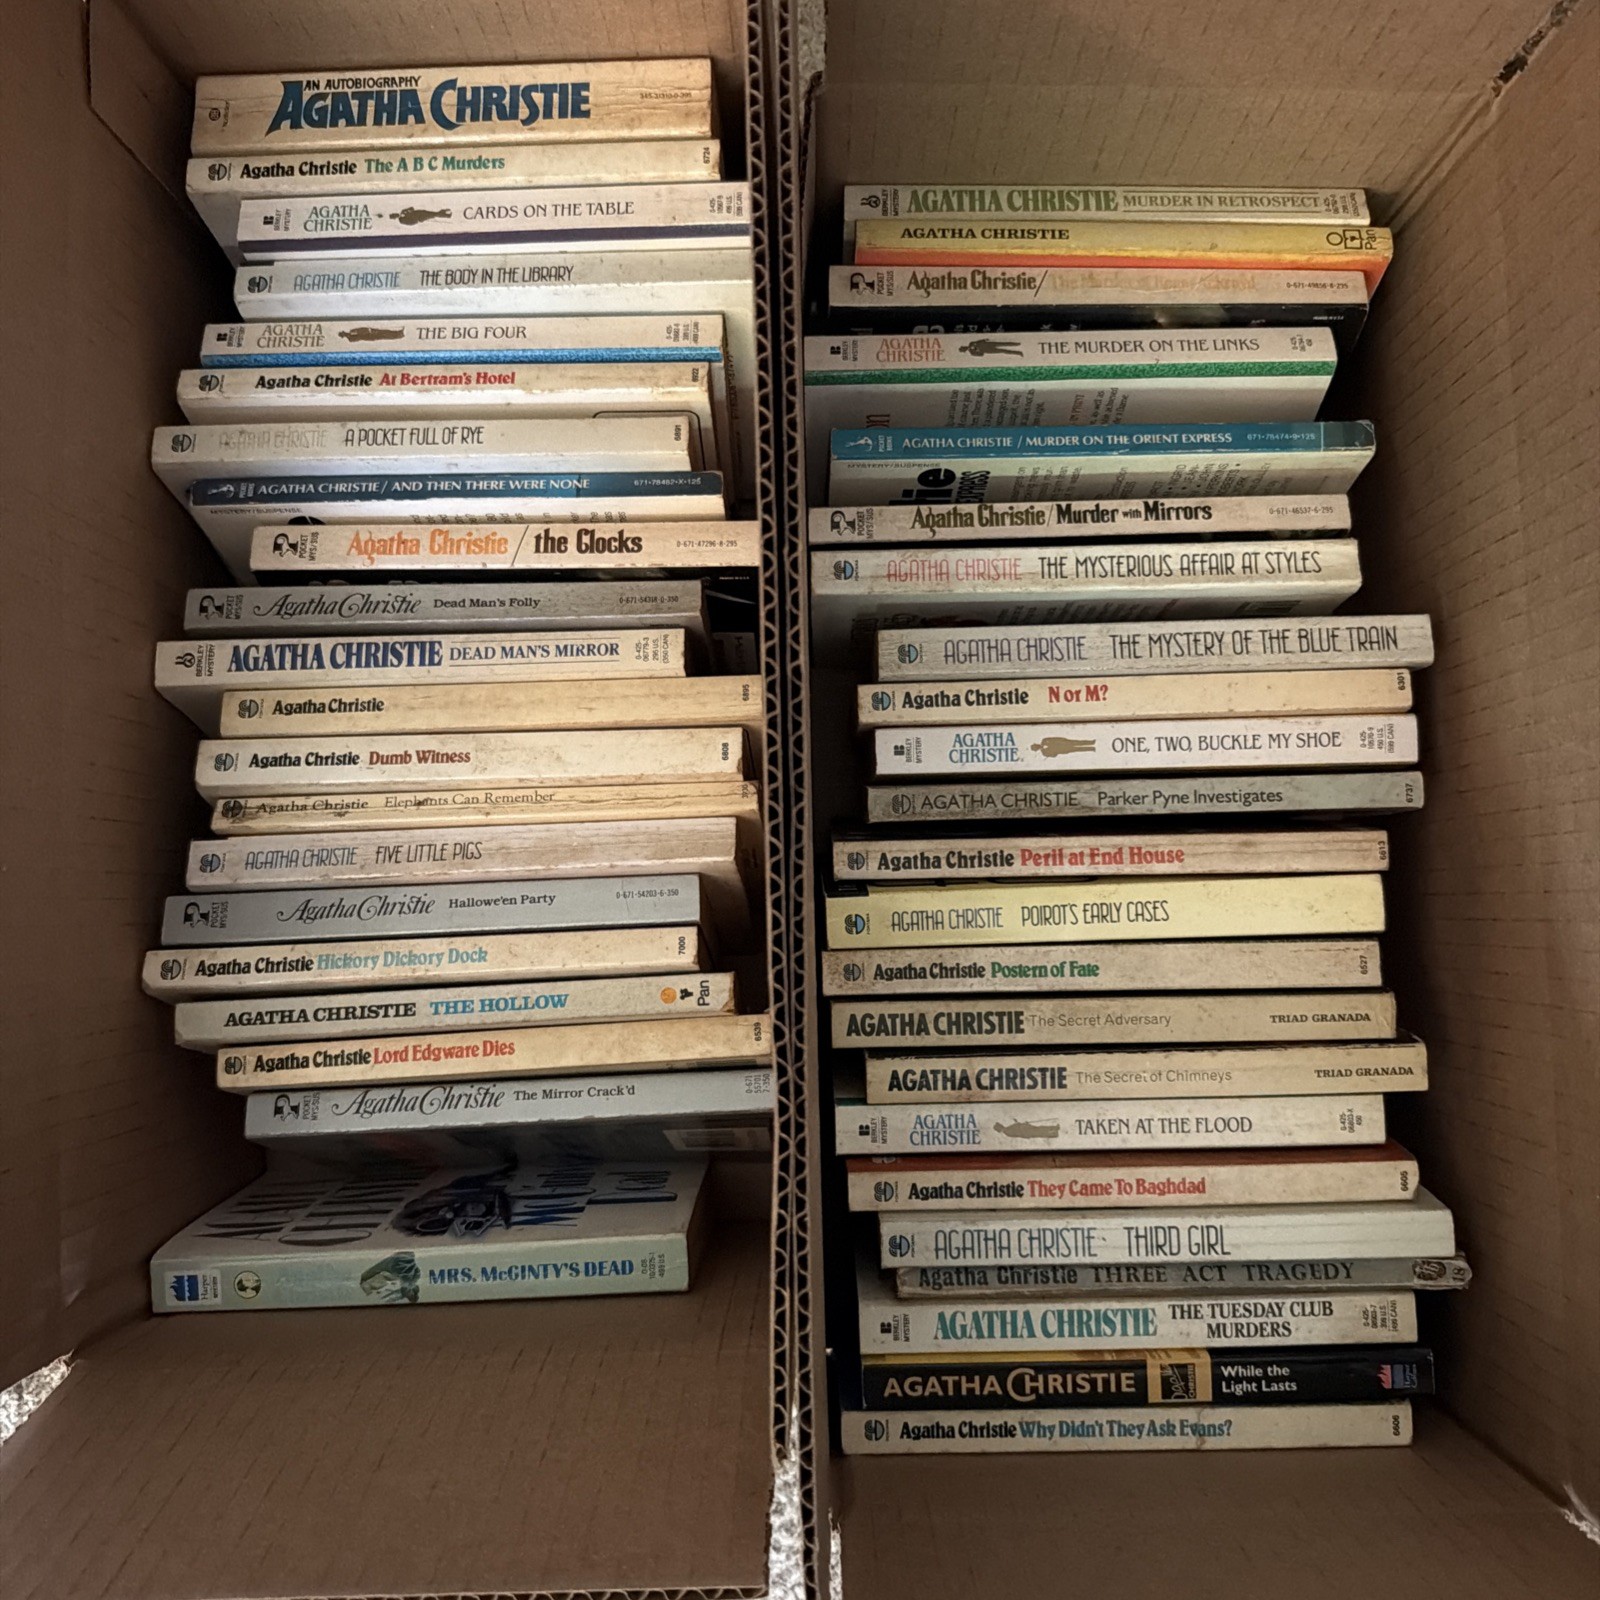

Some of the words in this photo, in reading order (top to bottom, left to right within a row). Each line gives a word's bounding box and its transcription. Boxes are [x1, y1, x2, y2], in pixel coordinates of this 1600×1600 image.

[324, 76, 422, 89] AUTOBIOGRAPHY
[265, 80, 426, 137] AGATHA
[431, 77, 590, 131] CHRISTIE
[364, 158, 393, 173] The
[442, 155, 505, 170] Murders
[463, 206, 518, 220] CARDS
[554, 203, 582, 216] THE
[586, 202, 635, 215] TABLE
[907, 189, 1002, 213] AGATHA
[1007, 189, 1118, 212] CHRISTIE
[1123, 195, 1192, 208] MURDER
[1217, 195, 1320, 208] RETROSPECT
[901, 228, 976, 240] AGATHA
[980, 228, 1069, 240] CHRISTIE
[1365, 230, 1376, 250] Pan
[420, 270, 442, 285] THE
[445, 268, 478, 285] BODY
[497, 267, 519, 283] THE
[522, 266, 574, 282] LIBRARY
[417, 327, 447, 339] THE
[451, 327, 478, 339] BIG
[484, 326, 527, 339] FOUR
[1038, 341, 1070, 355] THE
[1074, 340, 1144, 354] MURDER
[1176, 339, 1209, 351] THE
[1213, 338, 1260, 350] LINKS
[401, 372, 471, 386] Bertram's
[476, 372, 516, 385] Hotel
[359, 428, 405, 446] POCKET
[409, 427, 438, 445] FULL
[461, 426, 485, 445] RYE
[1106, 434, 1130, 445] THE
[1132, 433, 1179, 445] ORIENT
[1182, 433, 1232, 444] EXPRESS
[391, 482, 423, 492] AND
[427, 480, 461, 491] THEN
[465, 480, 506, 490] THERE
[509, 479, 546, 489] WERE
[550, 479, 590, 489] NONE
[1056, 504, 1117, 524] Murder
[1122, 509, 1141, 519] with
[1143, 500, 1212, 521] Mirrors
[299, 534, 307, 558] POCKET
[534, 529, 568, 554] the
[576, 528, 643, 554] Clocks
[1038, 556, 1068, 580] THE
[1075, 554, 1173, 579] MYSTERIOUS
[1180, 552, 1235, 576] AFFAIR
[1265, 551, 1322, 574] STYLES
[434, 598, 465, 608] Dead
[469, 598, 505, 608] Man's
[509, 597, 540, 609] Folly
[1109, 634, 1141, 659] THE
[1150, 631, 1225, 657] MYSTERY
[1258, 629, 1293, 655] THE
[1297, 627, 1342, 653] BLUE
[1346, 625, 1398, 651] TRAIN
[195, 645, 203, 677] BERKLEY
[207, 644, 215, 677] MYSTERY
[227, 644, 326, 672] AGATHA
[329, 641, 443, 669] CHRISTIE
[449, 646, 496, 661] DEAD
[500, 645, 550, 659] MAN'S
[555, 643, 620, 657] MIRROR
[1397, 672, 1405, 690] 6301
[742, 684, 750, 701] 6895
[272, 700, 325, 716] Agatha
[328, 697, 385, 713] Christie
[721, 742, 729, 760] 6808
[1112, 737, 1150, 753] ONE,
[1155, 736, 1192, 751] TWO,
[1199, 735, 1263, 750] BUCKLE
[1296, 732, 1341, 748] SHOE
[369, 751, 412, 765] Dumb
[417, 750, 471, 764] Witness
[385, 796, 449, 808] Elephants
[453, 793, 479, 805] Can
[485, 791, 555, 804] Remember
[1098, 792, 1149, 806] Parker
[1153, 790, 1189, 808] Pyne
[1194, 789, 1283, 806] Investigates
[375, 845, 403, 864] FIVE
[407, 843, 447, 863] LITTLE
[453, 841, 482, 860] PIGS
[1020, 849, 1063, 866] Peril
[1089, 848, 1123, 865] End
[1129, 847, 1185, 864] House
[449, 896, 517, 909] Hallowe'en
[521, 894, 556, 906] Party
[211, 902, 219, 928] POCKET
[1022, 904, 1078, 926] POIROT'S
[1082, 902, 1121, 924] EARLY
[1127, 900, 1169, 922] CASES
[317, 953, 378, 971] Hickory
[384, 950, 445, 968] Dickory
[448, 947, 488, 964] Dock
[991, 962, 1048, 978] Postern
[1069, 961, 1099, 977] Fate
[697, 980, 710, 1007] Pan
[430, 999, 474, 1015] THE
[480, 993, 569, 1013] HOLLOW
[754, 1022, 762, 1042] 6539
[847, 1013, 930, 1036] AGATHA
[934, 1011, 1024, 1035] CHRISTIE
[1029, 1015, 1055, 1027] The
[1058, 1015, 1100, 1027] Secret
[1104, 1013, 1171, 1027] Adversary
[374, 1046, 408, 1064] Lord
[412, 1042, 479, 1062] Edgware
[483, 1040, 515, 1056] Dies
[1077, 1072, 1101, 1083] The
[1104, 1072, 1148, 1083] Secret
[1166, 1069, 1232, 1084] Chimneys
[513, 1090, 538, 1101] The
[541, 1088, 584, 1099] Mirror
[587, 1085, 635, 1098] Crack'd
[1075, 1119, 1130, 1135] TAKEN
[1158, 1118, 1191, 1133] THE
[1196, 1117, 1252, 1133] FLOOD
[1027, 1180, 1065, 1198] They
[1069, 1180, 1112, 1197] Came
[1135, 1177, 1206, 1196] Baghdad
[1400, 1170, 1408, 1191] 6605
[1123, 1226, 1181, 1257] THIRD
[1187, 1225, 1231, 1256] GIRL
[429, 1268, 477, 1284] MRS.
[480, 1262, 580, 1282] McGINTY'S
[584, 1259, 634, 1277] DEAD
[1182, 1265, 1226, 1282] ACT
[1242, 1263, 1354, 1281] TRAGEDY
[933, 1309, 1036, 1340] AGATHA
[1040, 1307, 1158, 1338] CHRISTIE
[1168, 1304, 1203, 1320] THE
[1208, 1302, 1285, 1319] TUESDAY
[1289, 1301, 1334, 1317] CLUB
[1207, 1322, 1292, 1338] MURDERS
[1221, 1365, 1263, 1377] While
[1267, 1365, 1290, 1376] the
[883, 1375, 1003, 1397] AGATHA
[1007, 1367, 1136, 1402] CHRISTIE
[1222, 1381, 1258, 1395] Light
[1261, 1380, 1297, 1392] Lasts
[1019, 1421, 1055, 1440] Why
[1059, 1420, 1103, 1437] Didn't
[1107, 1420, 1143, 1439] They
[1180, 1419, 1232, 1436] Evans?
[1392, 1415, 1400, 1436] 6606
